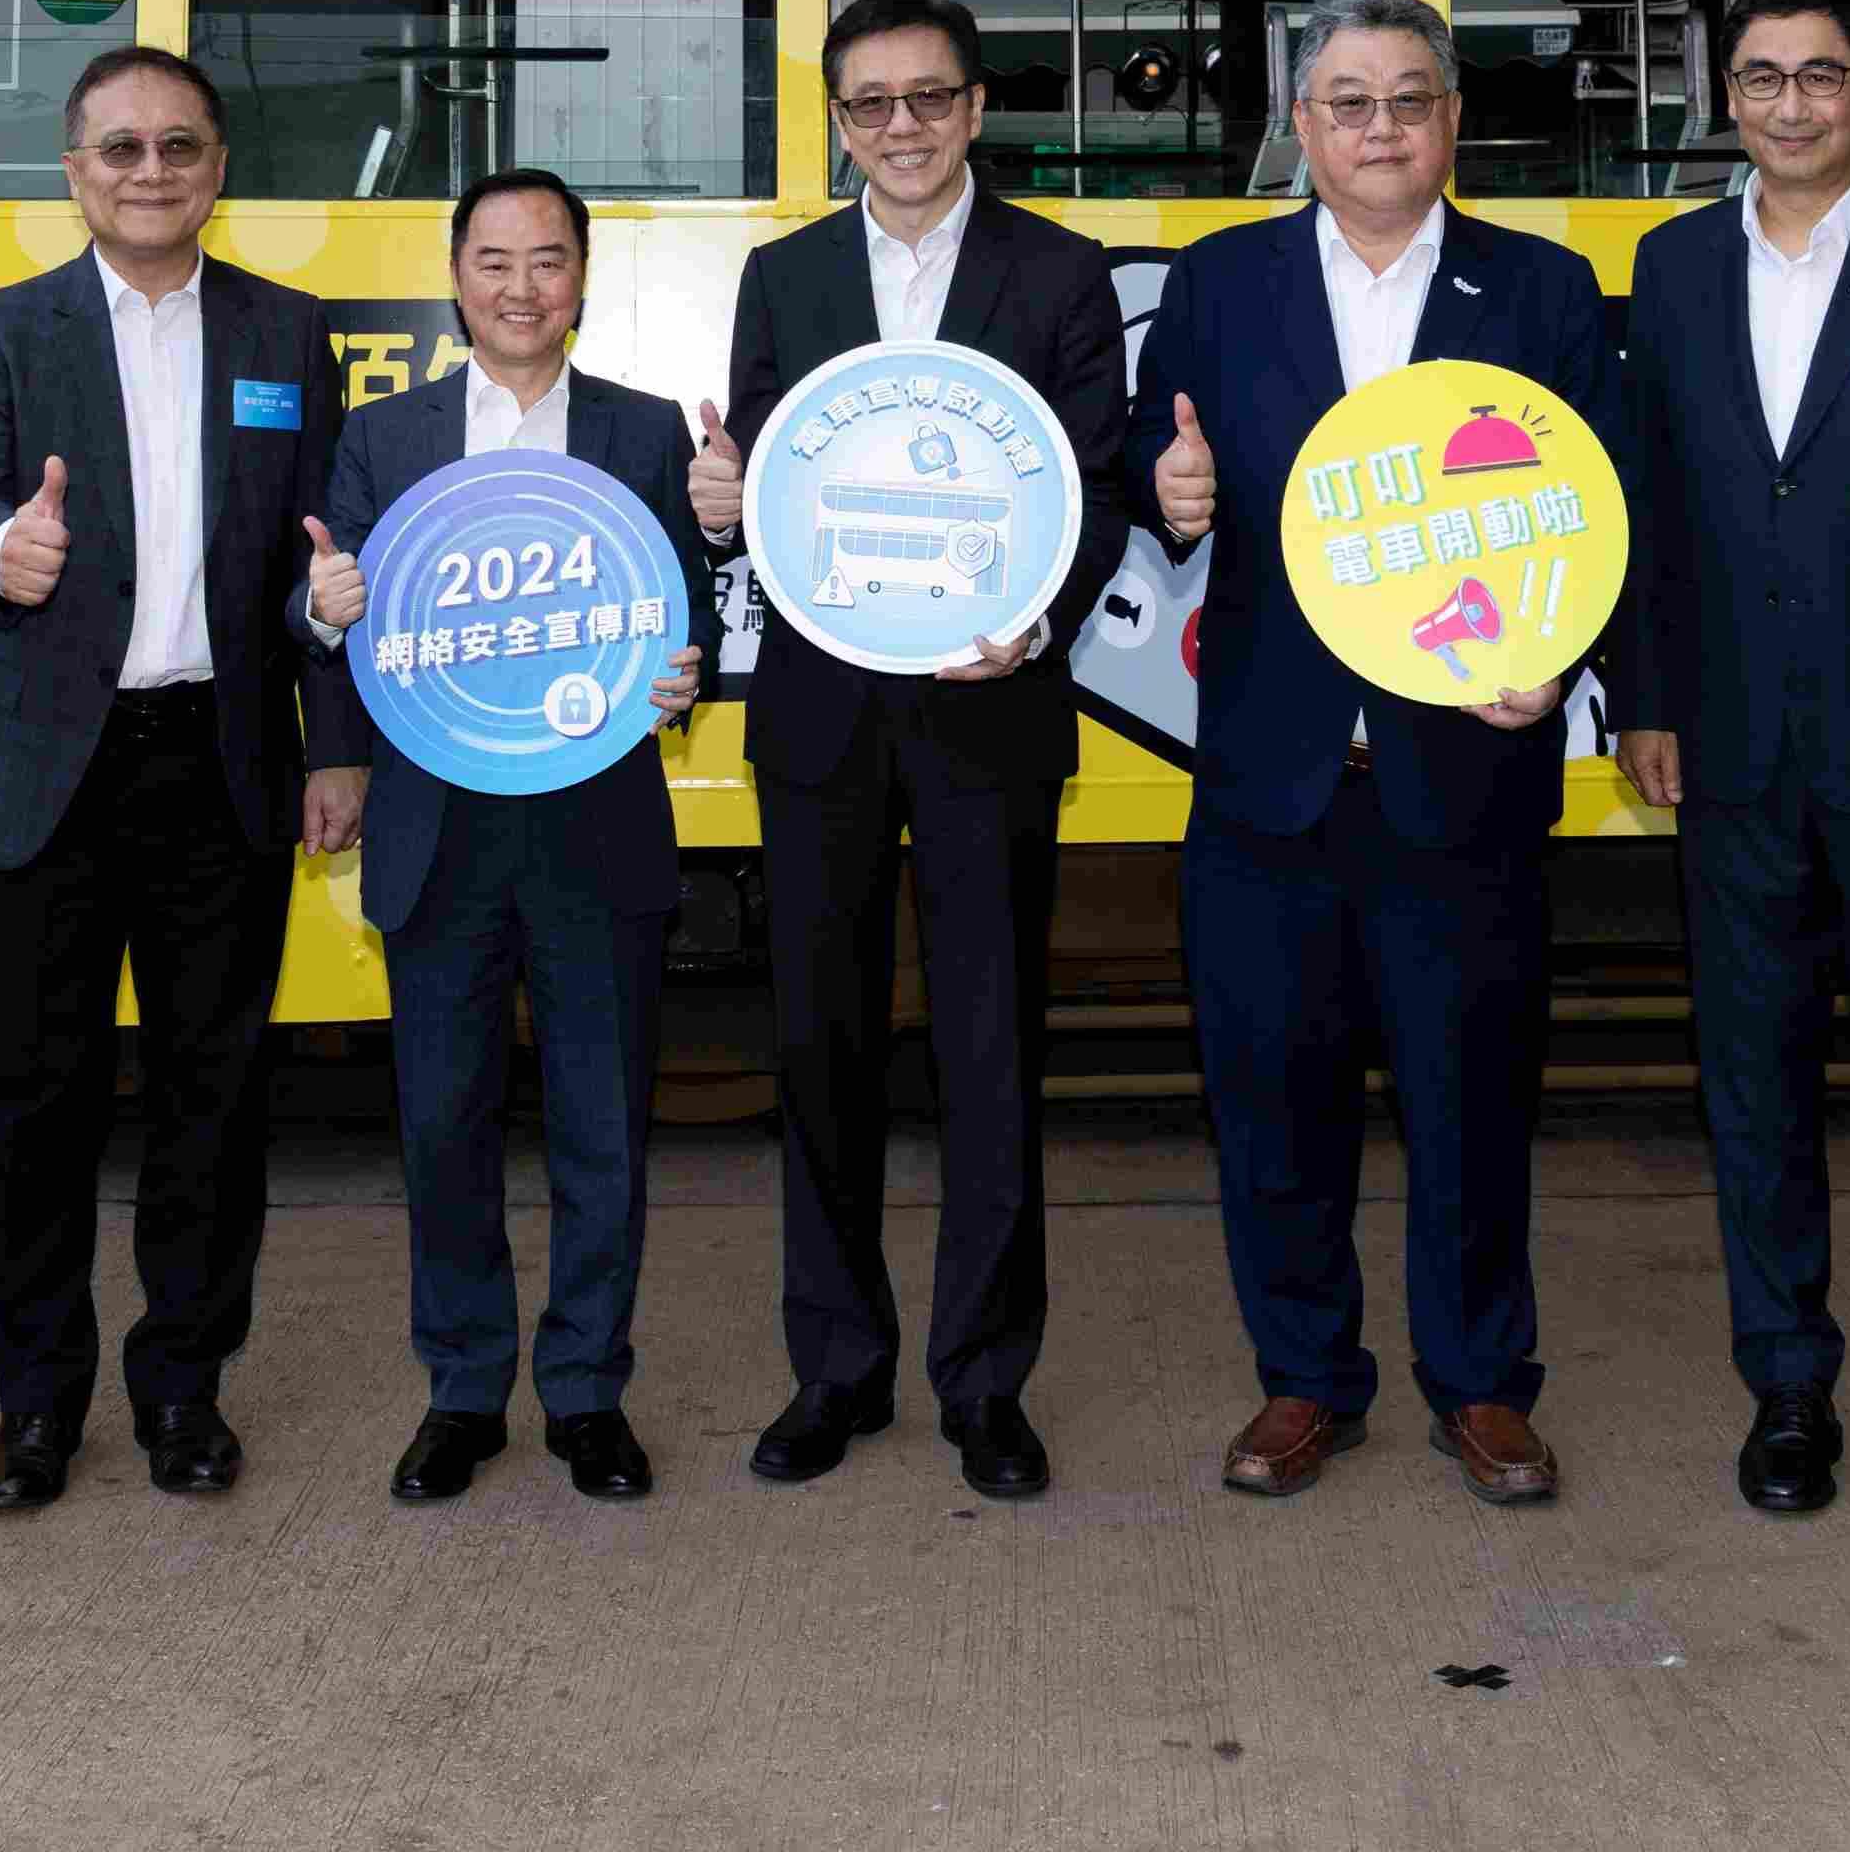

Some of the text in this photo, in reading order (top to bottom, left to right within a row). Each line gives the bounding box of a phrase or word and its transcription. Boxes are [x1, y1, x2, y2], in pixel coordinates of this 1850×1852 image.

[1305, 443, 1424, 522] 叮叮
[436, 533, 599, 609] 2024
[1325, 482, 1589, 587] 電車開動啦
[375, 595, 667, 675] 網絡安全宣傳周
